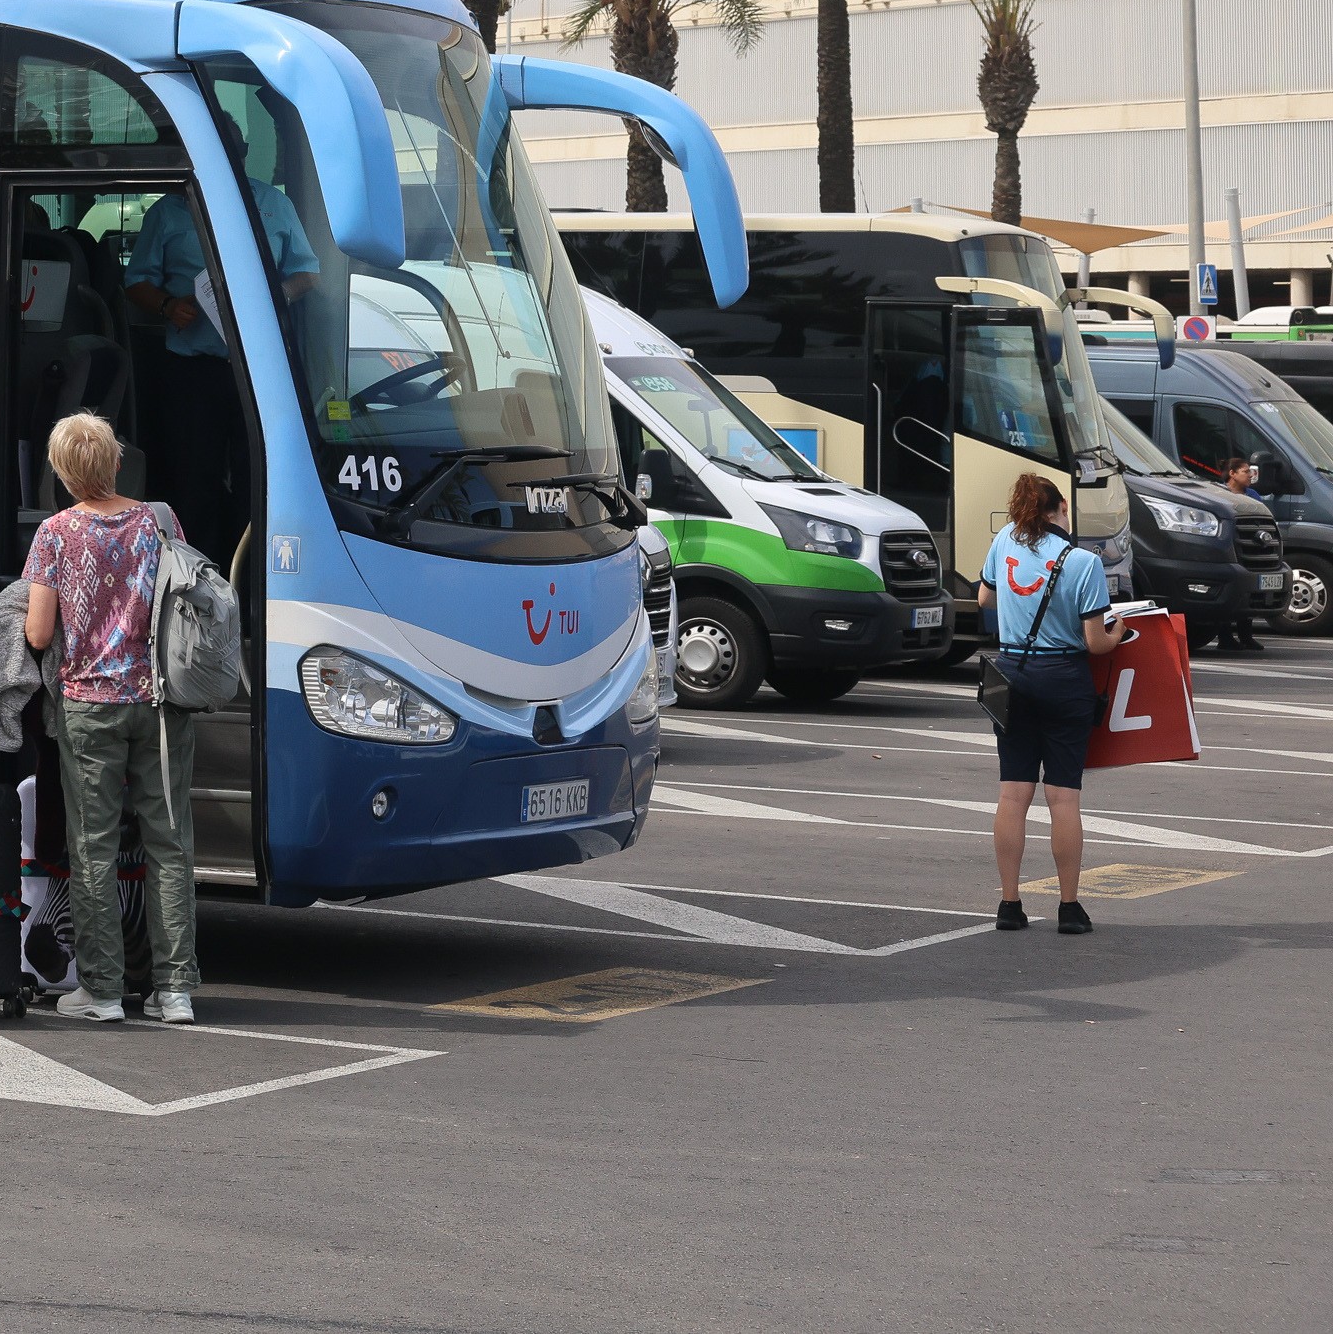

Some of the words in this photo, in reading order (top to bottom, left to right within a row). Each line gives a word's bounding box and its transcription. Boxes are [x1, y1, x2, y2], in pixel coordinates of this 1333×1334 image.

[338, 454, 402, 492] 416
[558, 610, 579, 634] TUI
[530, 787, 562, 817] 6516
[566, 784, 587, 813] KKB
